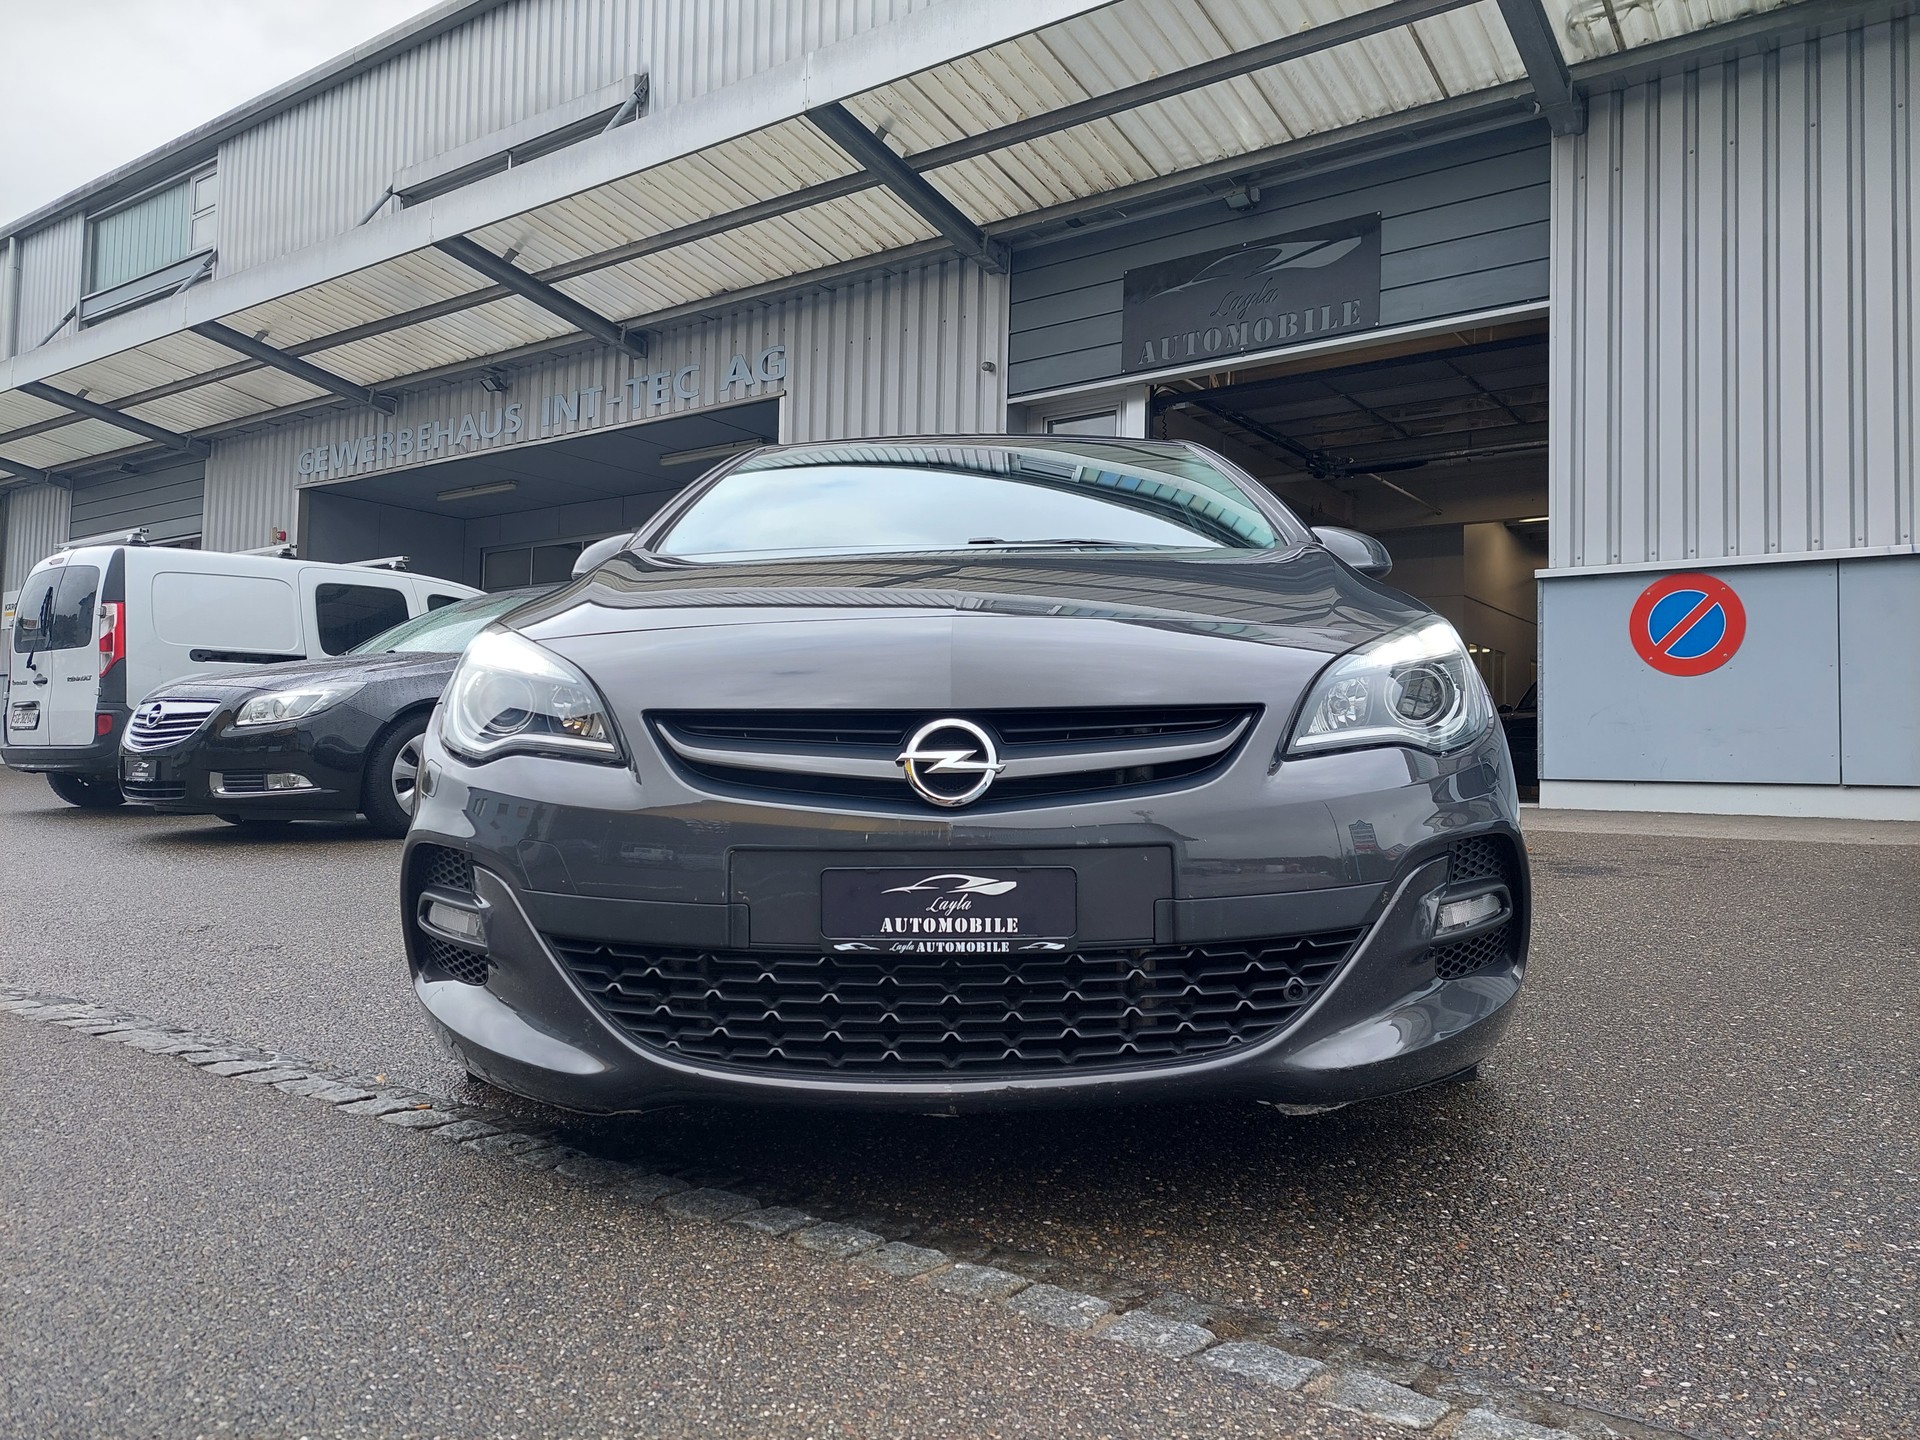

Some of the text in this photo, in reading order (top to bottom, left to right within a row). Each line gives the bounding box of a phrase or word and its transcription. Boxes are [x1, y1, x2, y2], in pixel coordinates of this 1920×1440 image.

[1209, 277, 1279, 319] Layla
[1138, 298, 1361, 365] AUTOMOBILE
[297, 402, 523, 475] GEWERBEHAUS
[719, 345, 787, 392] AG
[925, 893, 972, 916] Layla
[880, 917, 1018, 933] AUTOMOBILE
[889, 941, 1010, 954] Layla AUTOMOBILE
